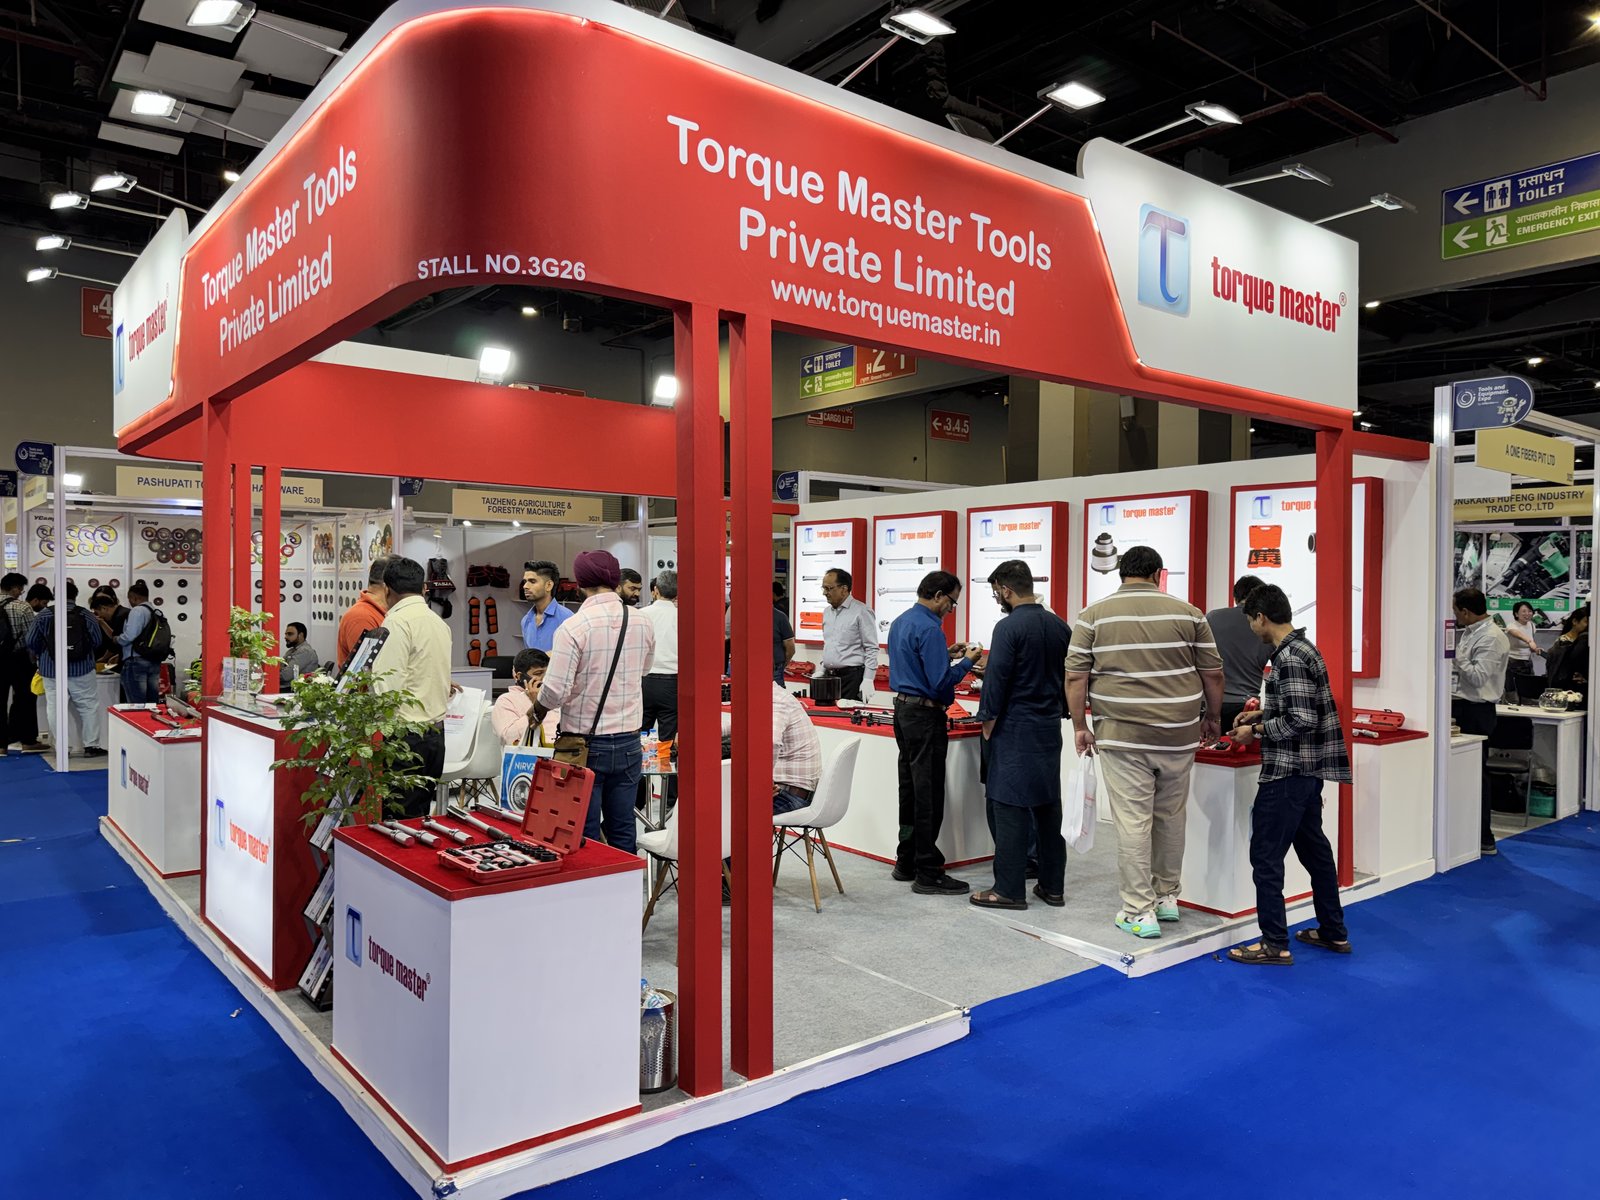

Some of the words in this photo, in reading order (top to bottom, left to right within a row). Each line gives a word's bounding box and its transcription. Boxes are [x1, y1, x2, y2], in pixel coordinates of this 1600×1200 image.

[1517, 168, 1565, 189] प्रसाधन
[667, 115, 825, 204] Torque
[838, 170, 963, 244] Master
[969, 211, 1052, 270] Tools
[1518, 182, 1565, 203] TOILET
[1515, 205, 1568, 224] आपातकालीन
[1516, 216, 1575, 236] EMERGENCY
[1578, 211, 1600, 223] EXIT
[201, 252, 243, 310] Torque
[246, 200, 300, 275] Master
[303, 145, 357, 224] Tools
[417, 255, 479, 280] STALL
[485, 255, 587, 282] NO.3G26
[739, 207, 882, 282] Private
[893, 248, 1015, 317] Limited
[219, 295, 265, 357] Private
[268, 235, 333, 324] Limited
[1211, 256, 1275, 315] torque
[771, 279, 1001, 347] www.torquemaster.in
[825, 360, 841, 369] TOILET
[823, 412, 841, 423] CARGO
[842, 415, 853, 425] LIFT
[1505, 444, 1509, 456] A
[1510, 445, 1520, 458] ONE
[1547, 454, 1555, 466] LTD
[137, 477, 192, 489] PASHUPATI
[482, 497, 516, 506] TAIZHENG
[518, 499, 566, 509] AGRICULTURE
[1281, 500, 1311, 511] torque
[1537, 490, 1585, 501] INDUSTRY
[488, 506, 525, 514] FORESTRY
[527, 508, 566, 517] MACHINERY
[1123, 508, 1147, 519] torque
[1148, 506, 1176, 517] master
[1486, 504, 1516, 513] TRADE
[998, 521, 1018, 533] torque
[1019, 520, 1041, 531] master
[368, 935, 394, 974] torque
